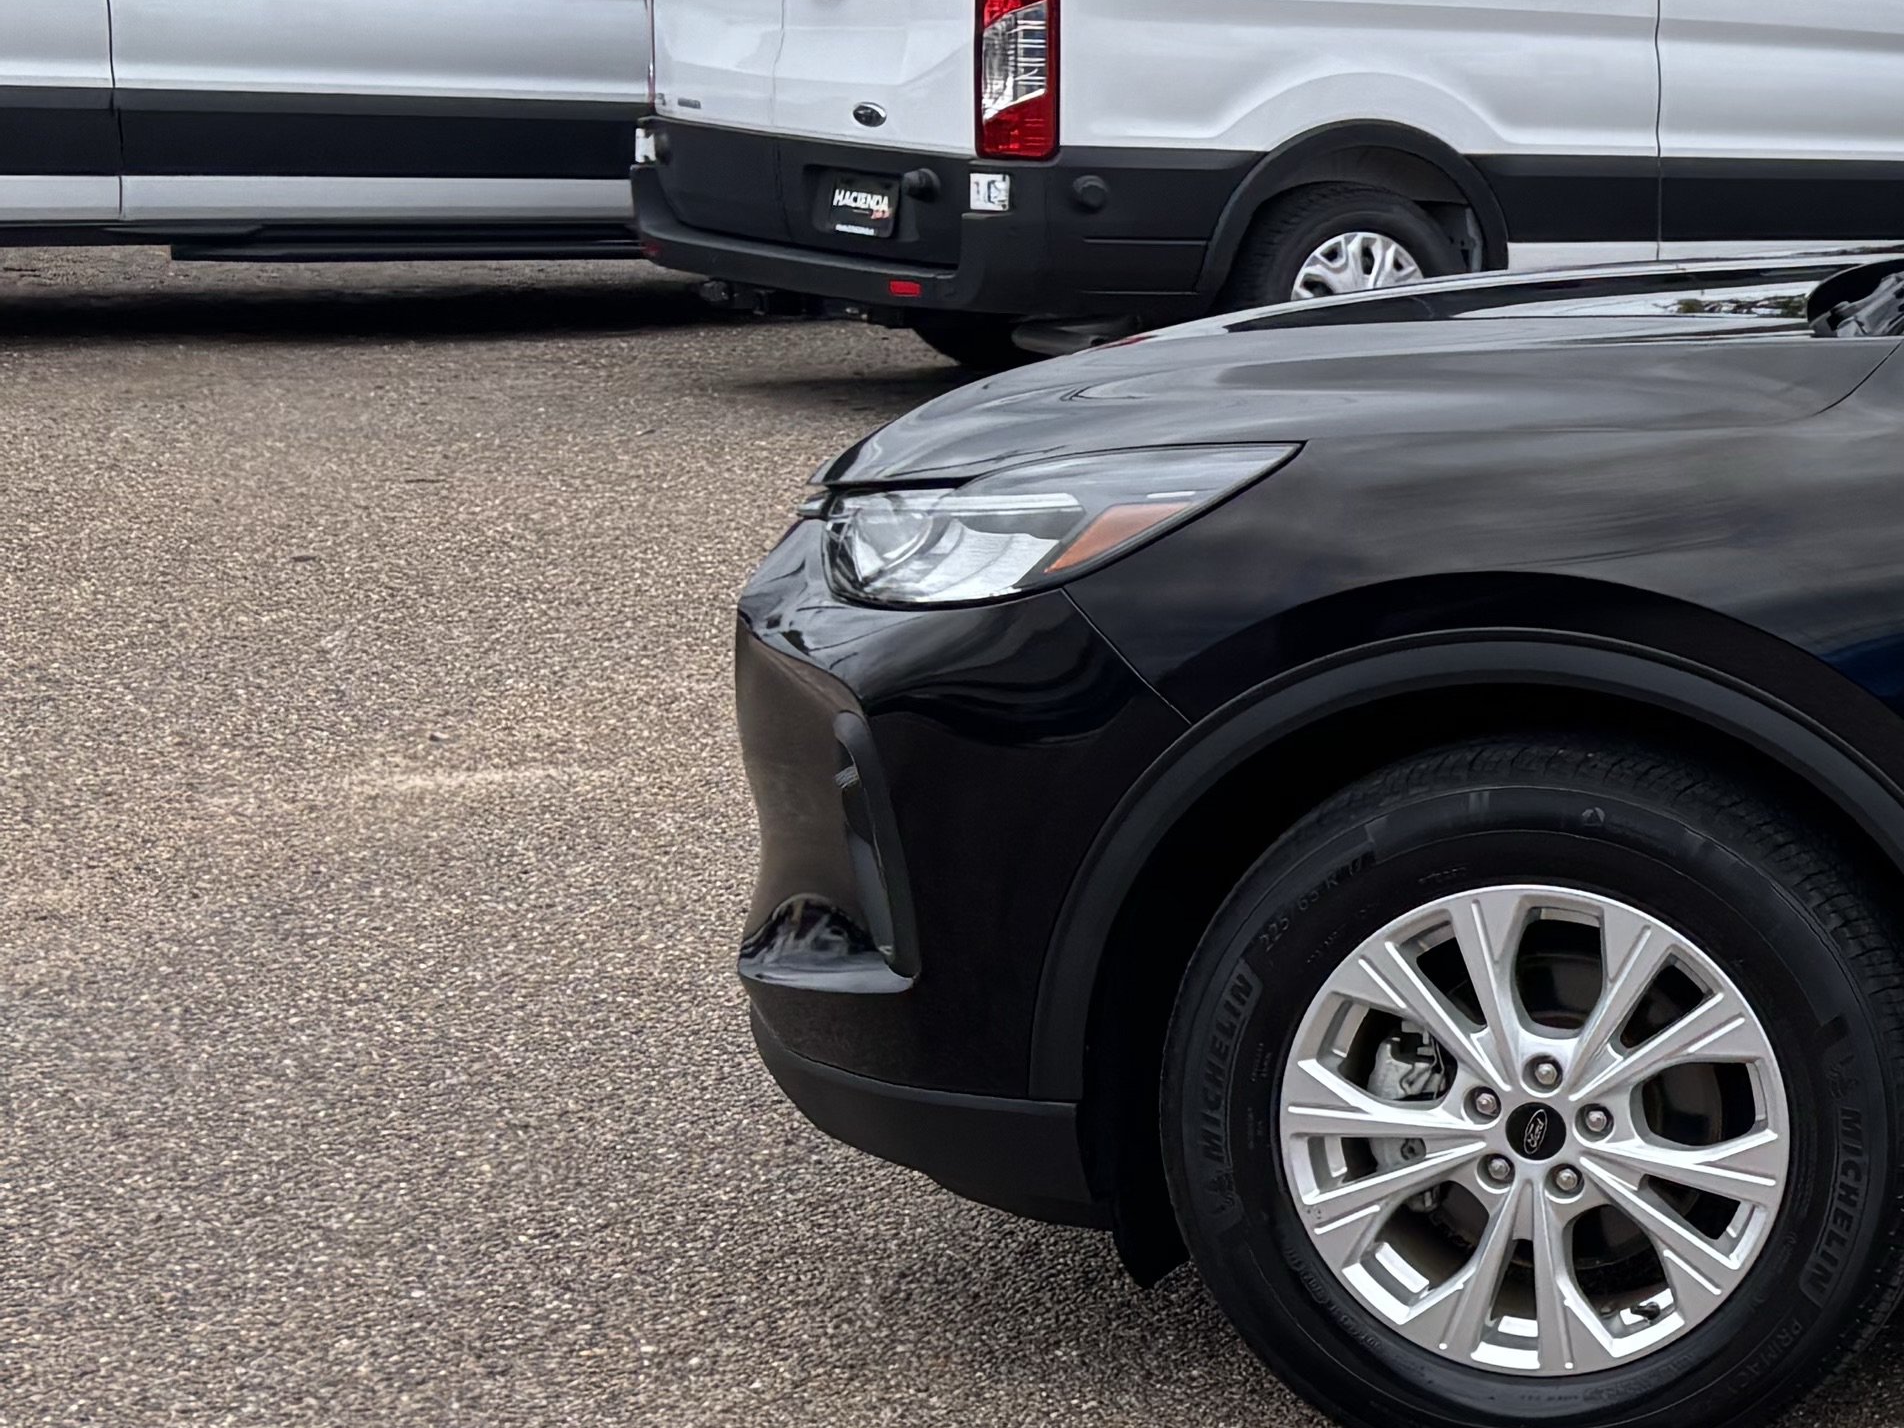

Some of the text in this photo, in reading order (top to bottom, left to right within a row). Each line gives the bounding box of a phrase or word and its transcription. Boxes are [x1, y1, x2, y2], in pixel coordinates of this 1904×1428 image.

[833, 189, 889, 211] HACIENDA
[1203, 973, 1254, 1163] MICHELIN
[1803, 1107, 1863, 1303] MICHELIN
